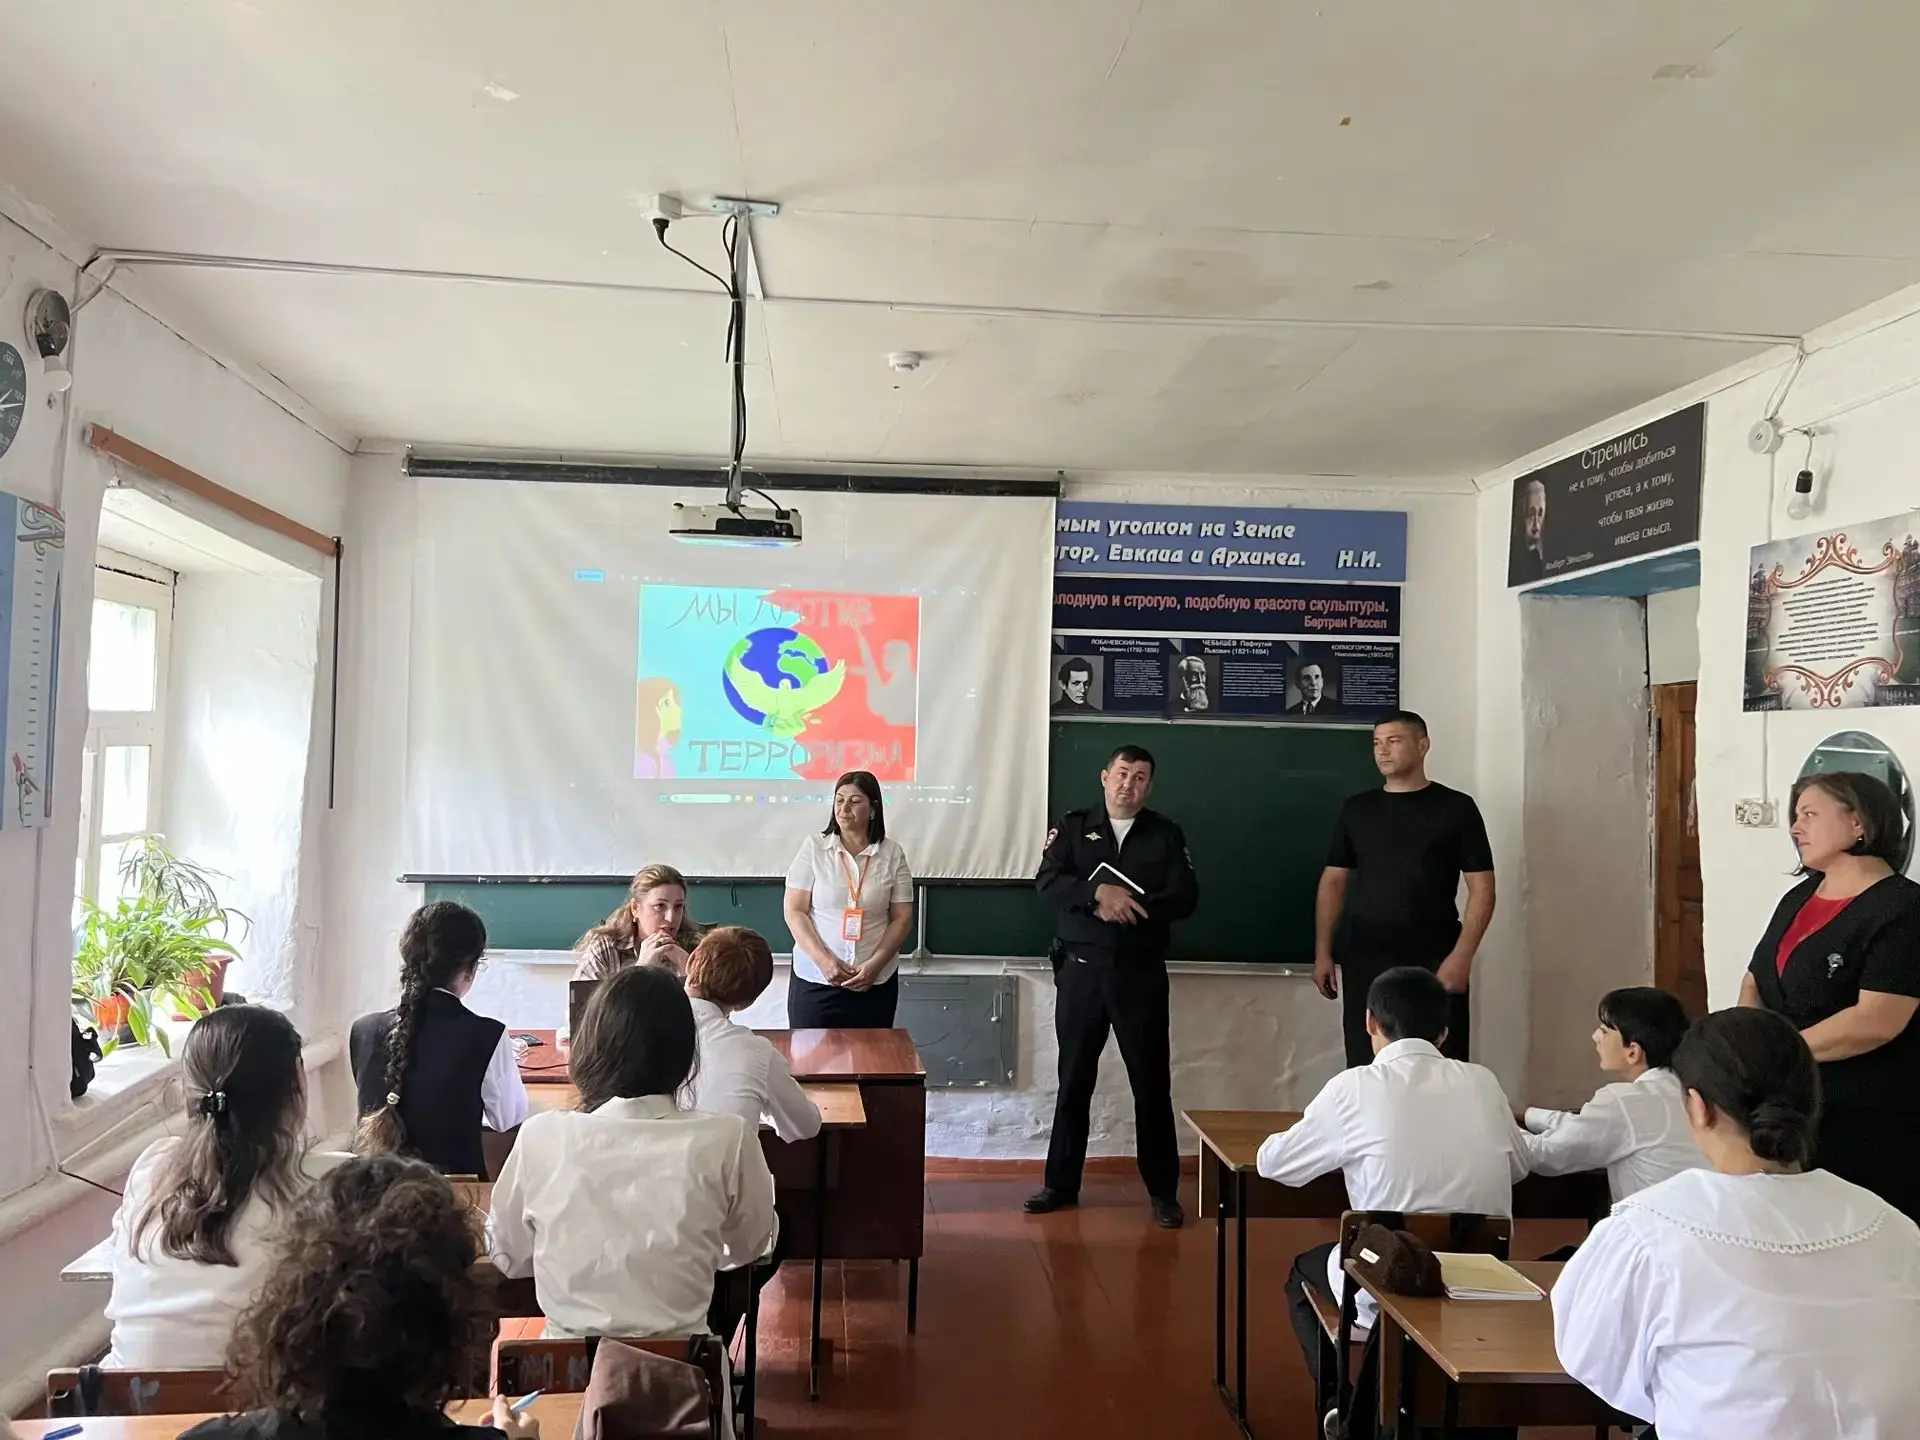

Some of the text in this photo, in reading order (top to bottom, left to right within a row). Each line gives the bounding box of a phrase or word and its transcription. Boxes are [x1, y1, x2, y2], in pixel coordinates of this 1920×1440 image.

[1608, 460, 1634, 478] чтобы
[1635, 445, 1676, 470] добиться
[1605, 472, 1675, 506] успеха, а к тому,
[1598, 497, 1674, 527] чтобы твоя жизнь
[1108, 520, 1193, 537] уголком
[1200, 523, 1226, 537] на
[1233, 520, 1296, 539] Земле
[1614, 521, 1672, 546] имела смысл.
[1109, 544, 1183, 563] Евклид
[1190, 550, 1203, 563] и
[1211, 547, 1306, 568] Архимед.
[1337, 550, 1382, 569] Н.И.
[1112, 595, 1120, 606] и
[1124, 595, 1181, 611] строгую,
[1185, 594, 1251, 612] подобную
[1254, 599, 1306, 613] красоте
[1309, 601, 1389, 615] скульптуры.
[1304, 615, 1387, 630] Бертран Рассел
